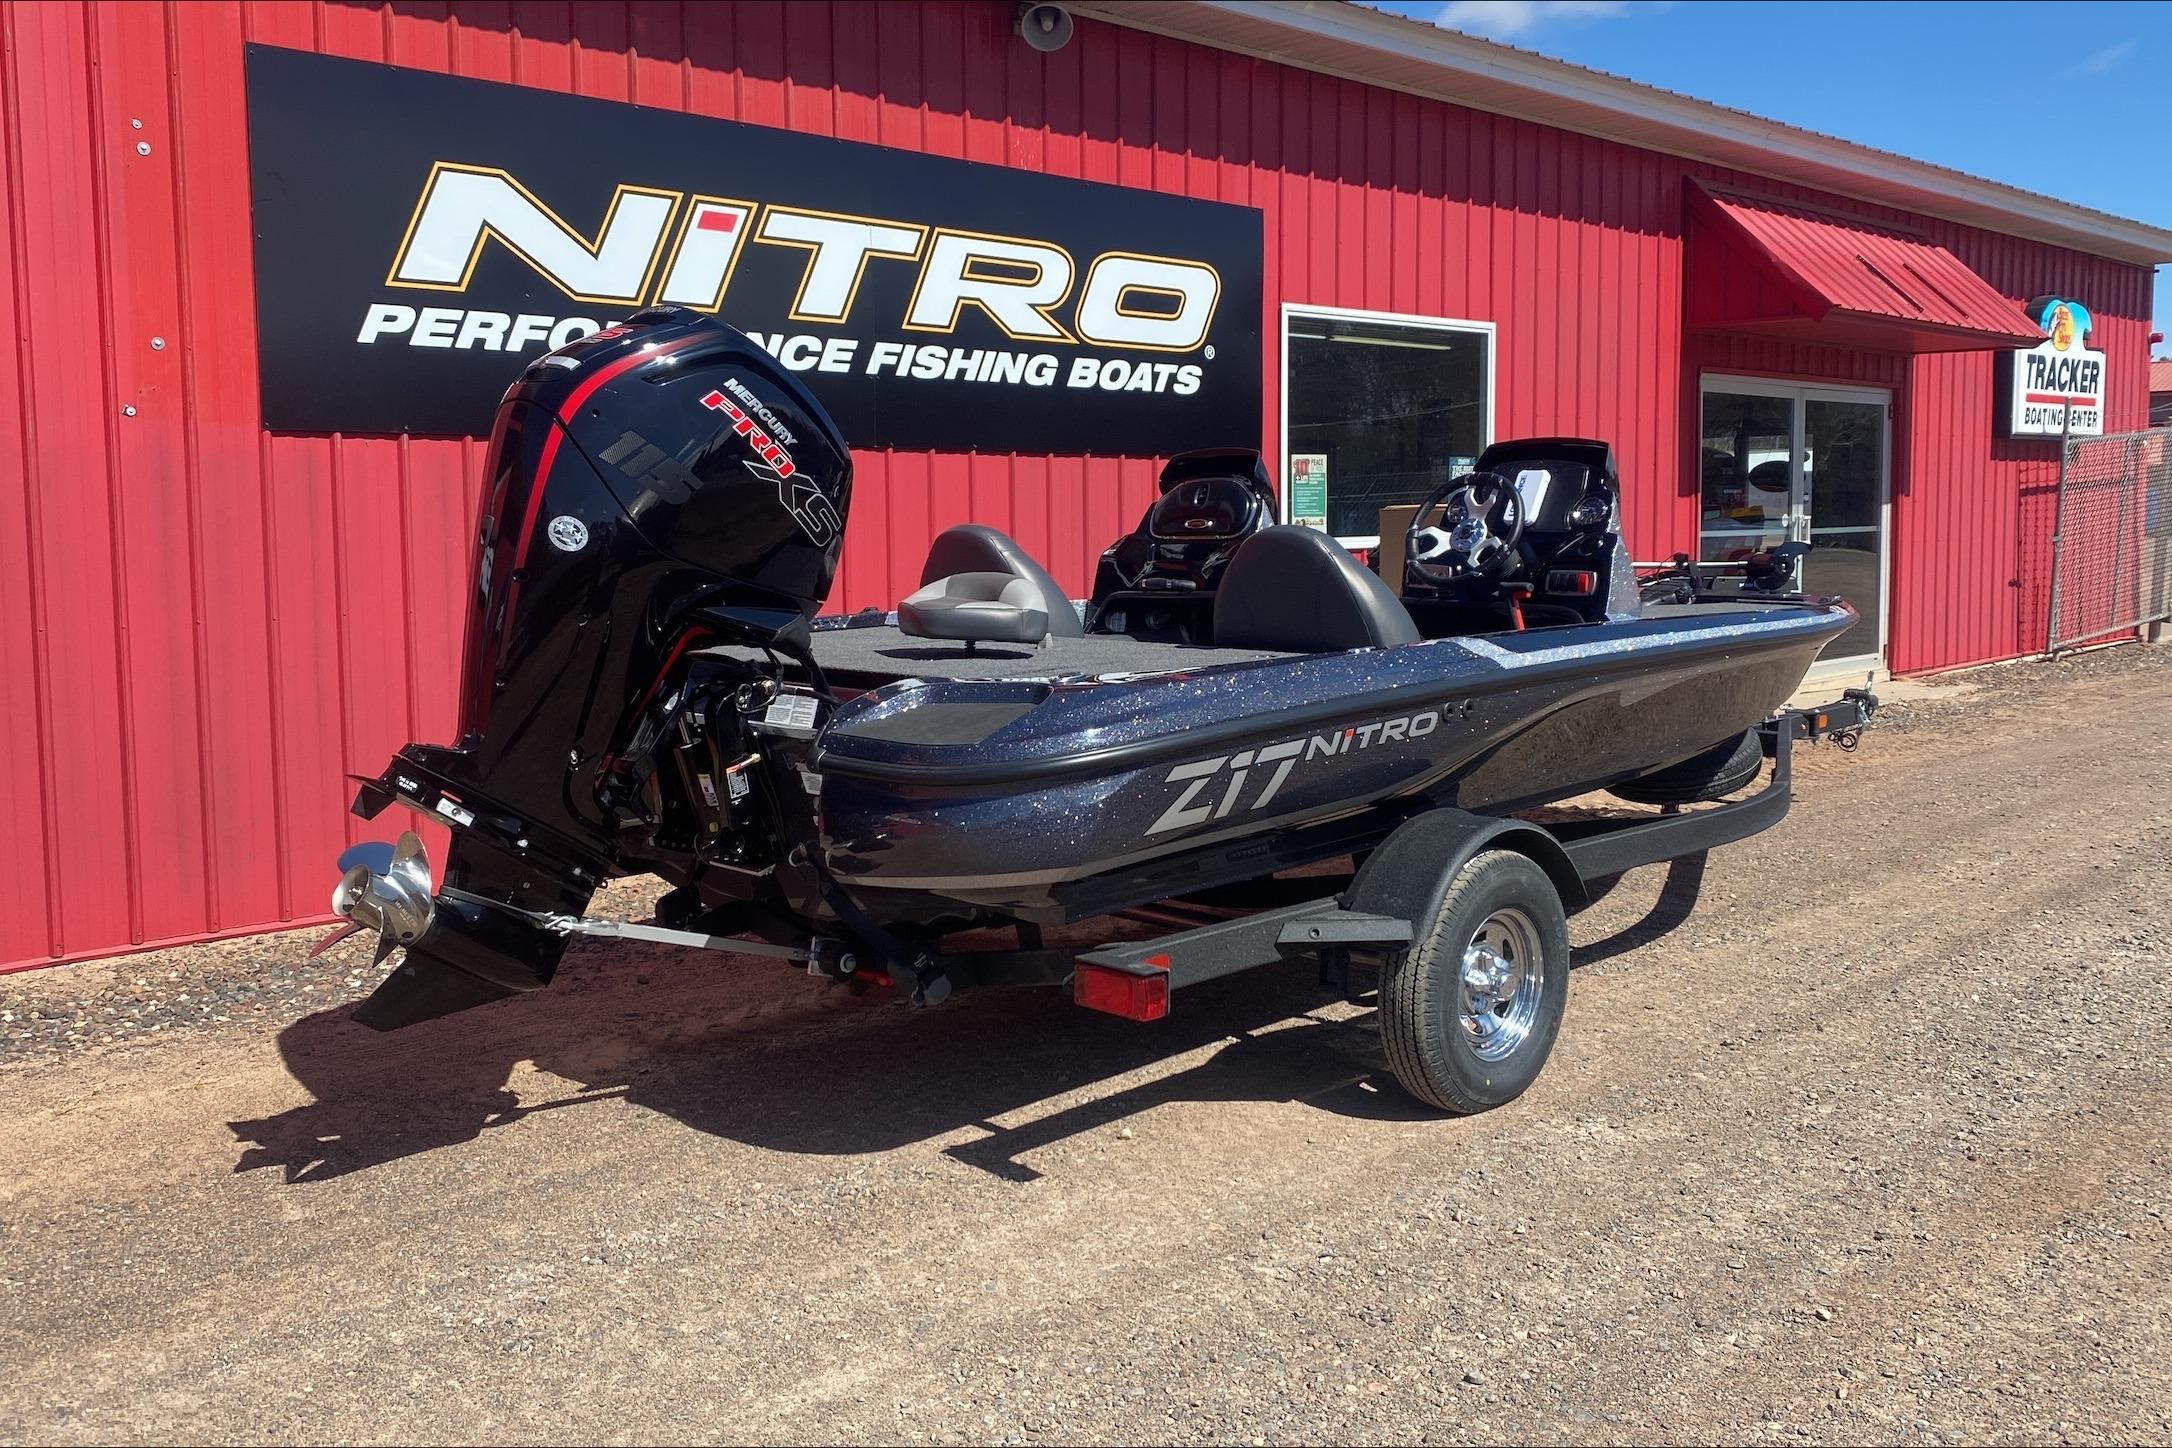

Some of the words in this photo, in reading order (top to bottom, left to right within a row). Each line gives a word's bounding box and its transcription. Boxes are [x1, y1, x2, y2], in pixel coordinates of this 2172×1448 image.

[866, 341, 1059, 387] FISHING
[1067, 358, 1203, 396] BOATS
[2026, 354, 2100, 394] TRACKER
[699, 390, 797, 480] PRO
[723, 377, 798, 446] MERCURY
[2024, 407, 2063, 426] BOATING
[2068, 409, 2098, 428] ENTER
[742, 439, 842, 547] XS
